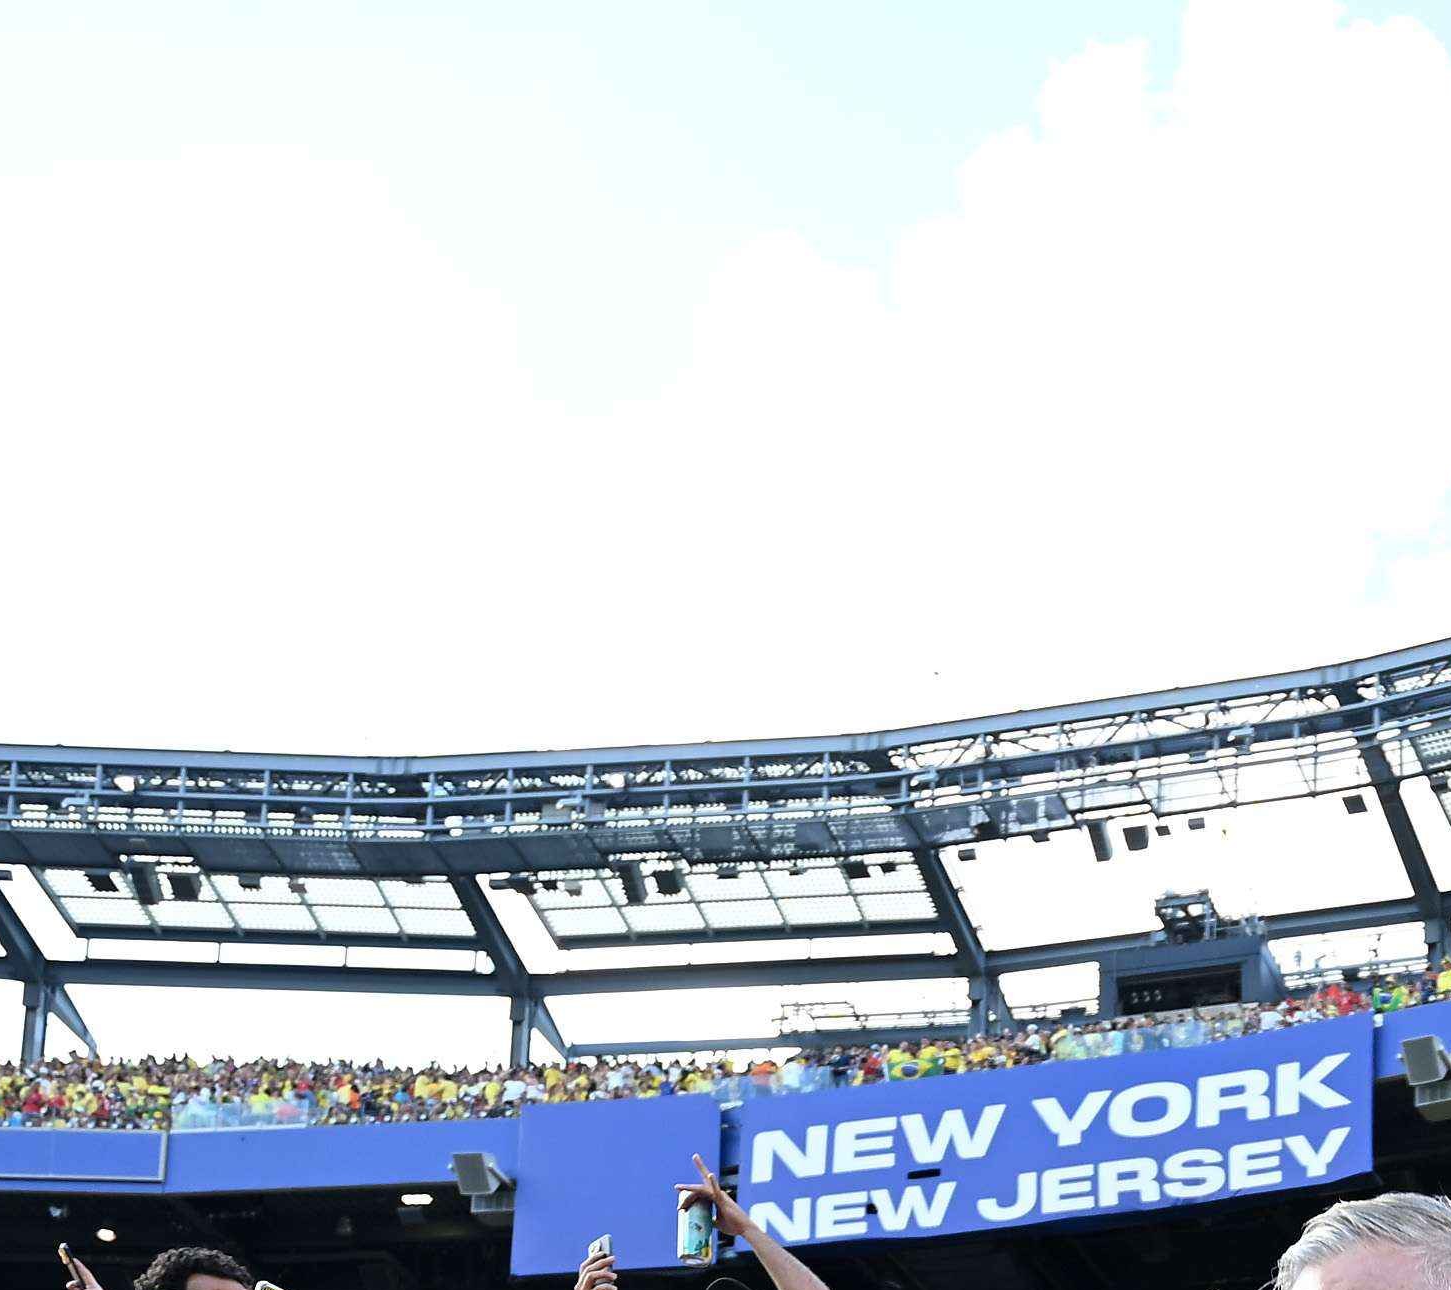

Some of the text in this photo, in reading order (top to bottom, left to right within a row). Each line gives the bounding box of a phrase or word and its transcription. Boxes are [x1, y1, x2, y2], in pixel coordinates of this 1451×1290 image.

[750, 1051, 1352, 1184] NEW YORK
[748, 1125, 1352, 1243] NEW JERSEY
